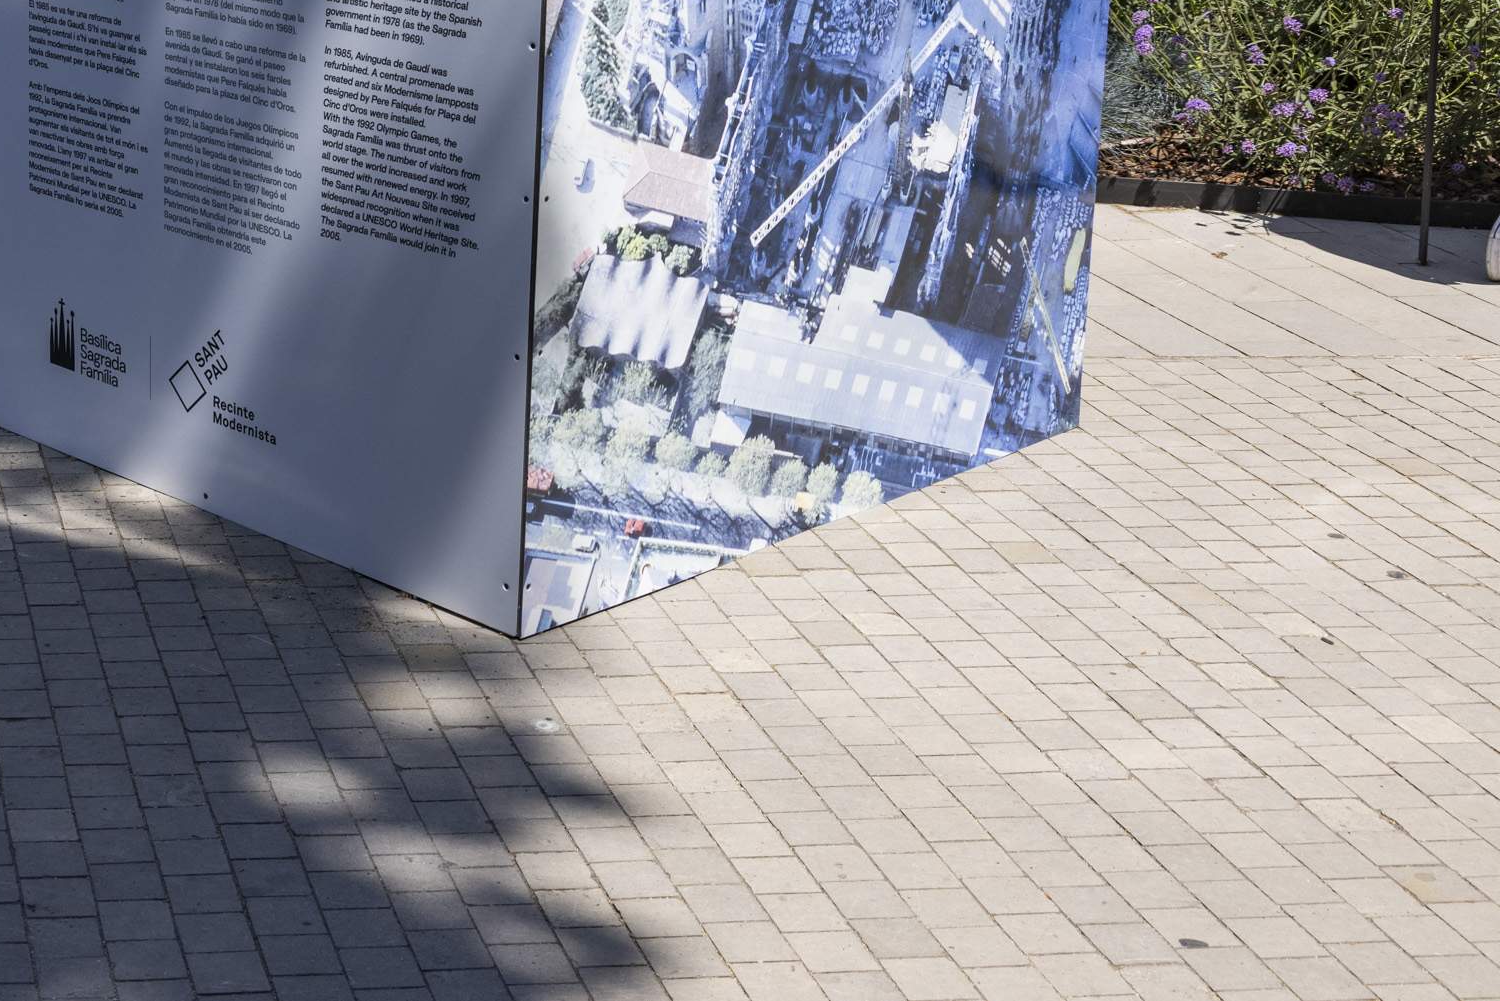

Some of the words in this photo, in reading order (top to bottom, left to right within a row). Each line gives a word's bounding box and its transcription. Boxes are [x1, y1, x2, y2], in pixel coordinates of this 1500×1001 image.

[321, 215, 335, 227] The
[336, 219, 368, 235] Sagrada
[370, 228, 397, 243] Família
[399, 237, 424, 250] would
[423, 242, 439, 254] join
[80, 327, 122, 355] Basílica
[194, 329, 225, 368] SANT
[80, 345, 126, 374] Sagrada
[204, 355, 228, 386] PAU
[80, 363, 119, 388] Família
[213, 396, 255, 421] Recinte
[213, 411, 277, 445] Modernista
